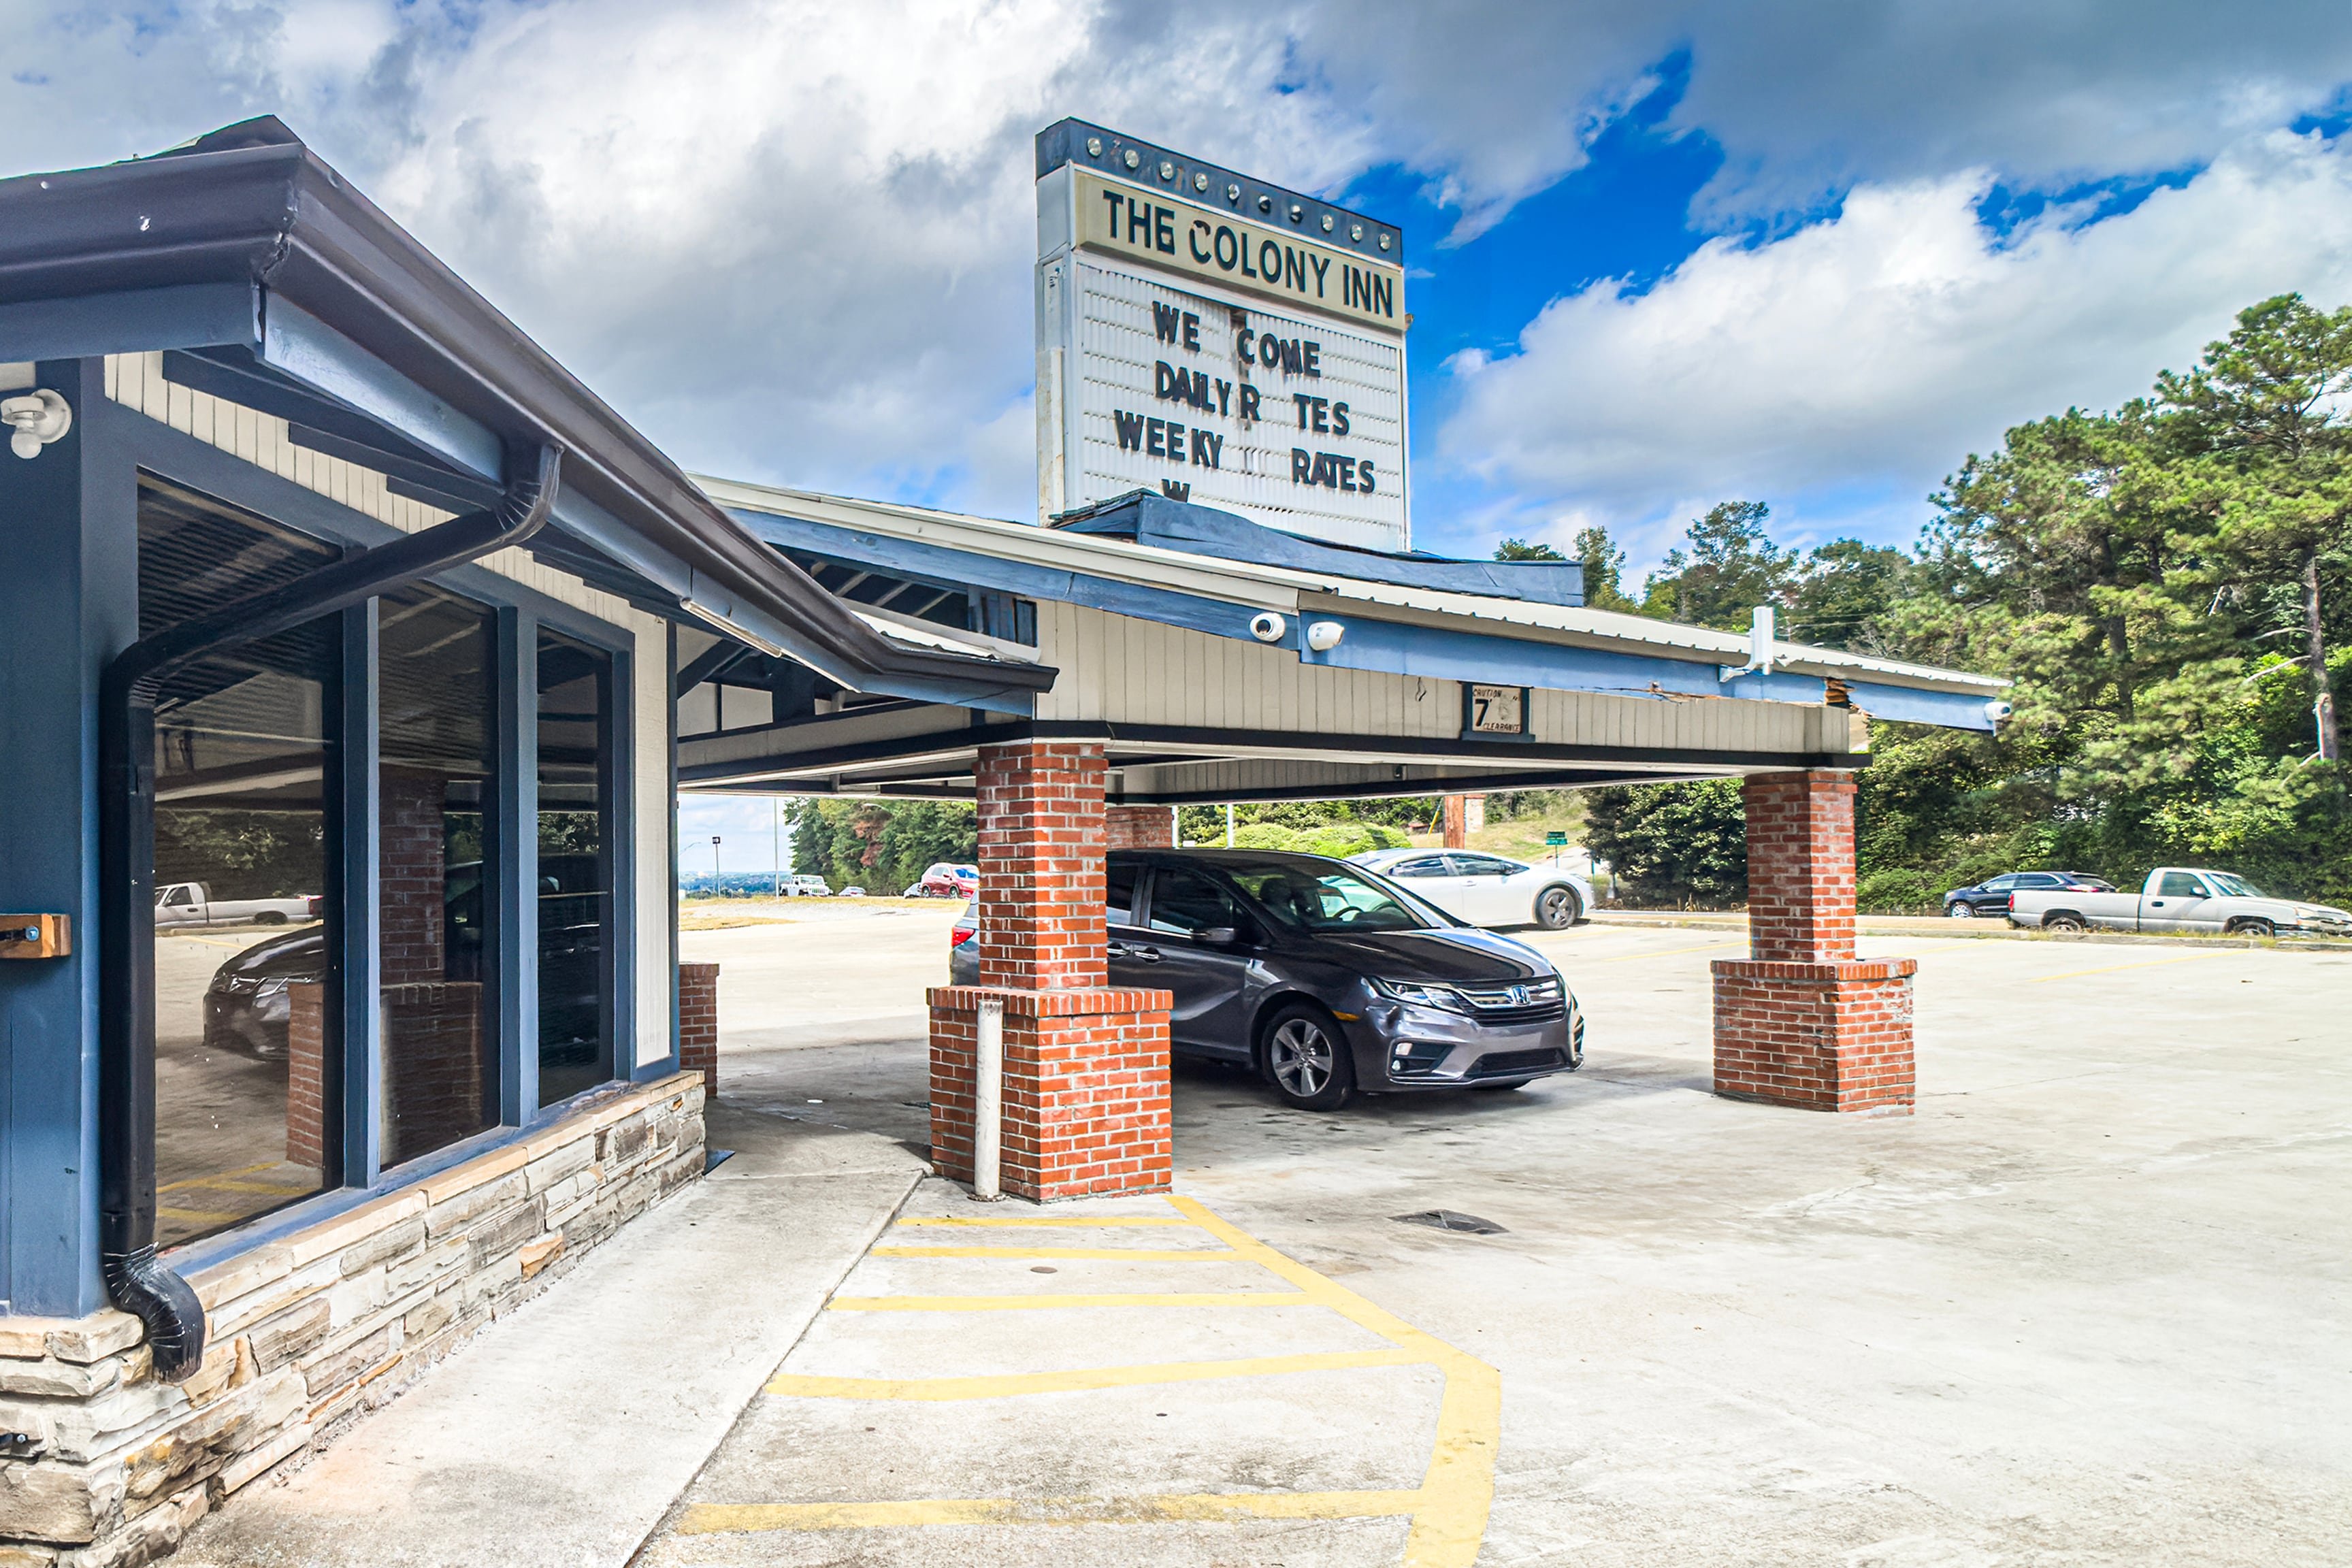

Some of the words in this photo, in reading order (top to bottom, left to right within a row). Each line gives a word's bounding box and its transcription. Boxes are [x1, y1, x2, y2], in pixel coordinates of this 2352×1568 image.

[1102, 189, 1175, 256] THE
[1188, 219, 1331, 299] COLONY
[1342, 263, 1394, 318] INN
[1236, 329, 1321, 378] COME
[1154, 360, 1232, 417] DAILY
[1291, 447, 1376, 495] RATES
